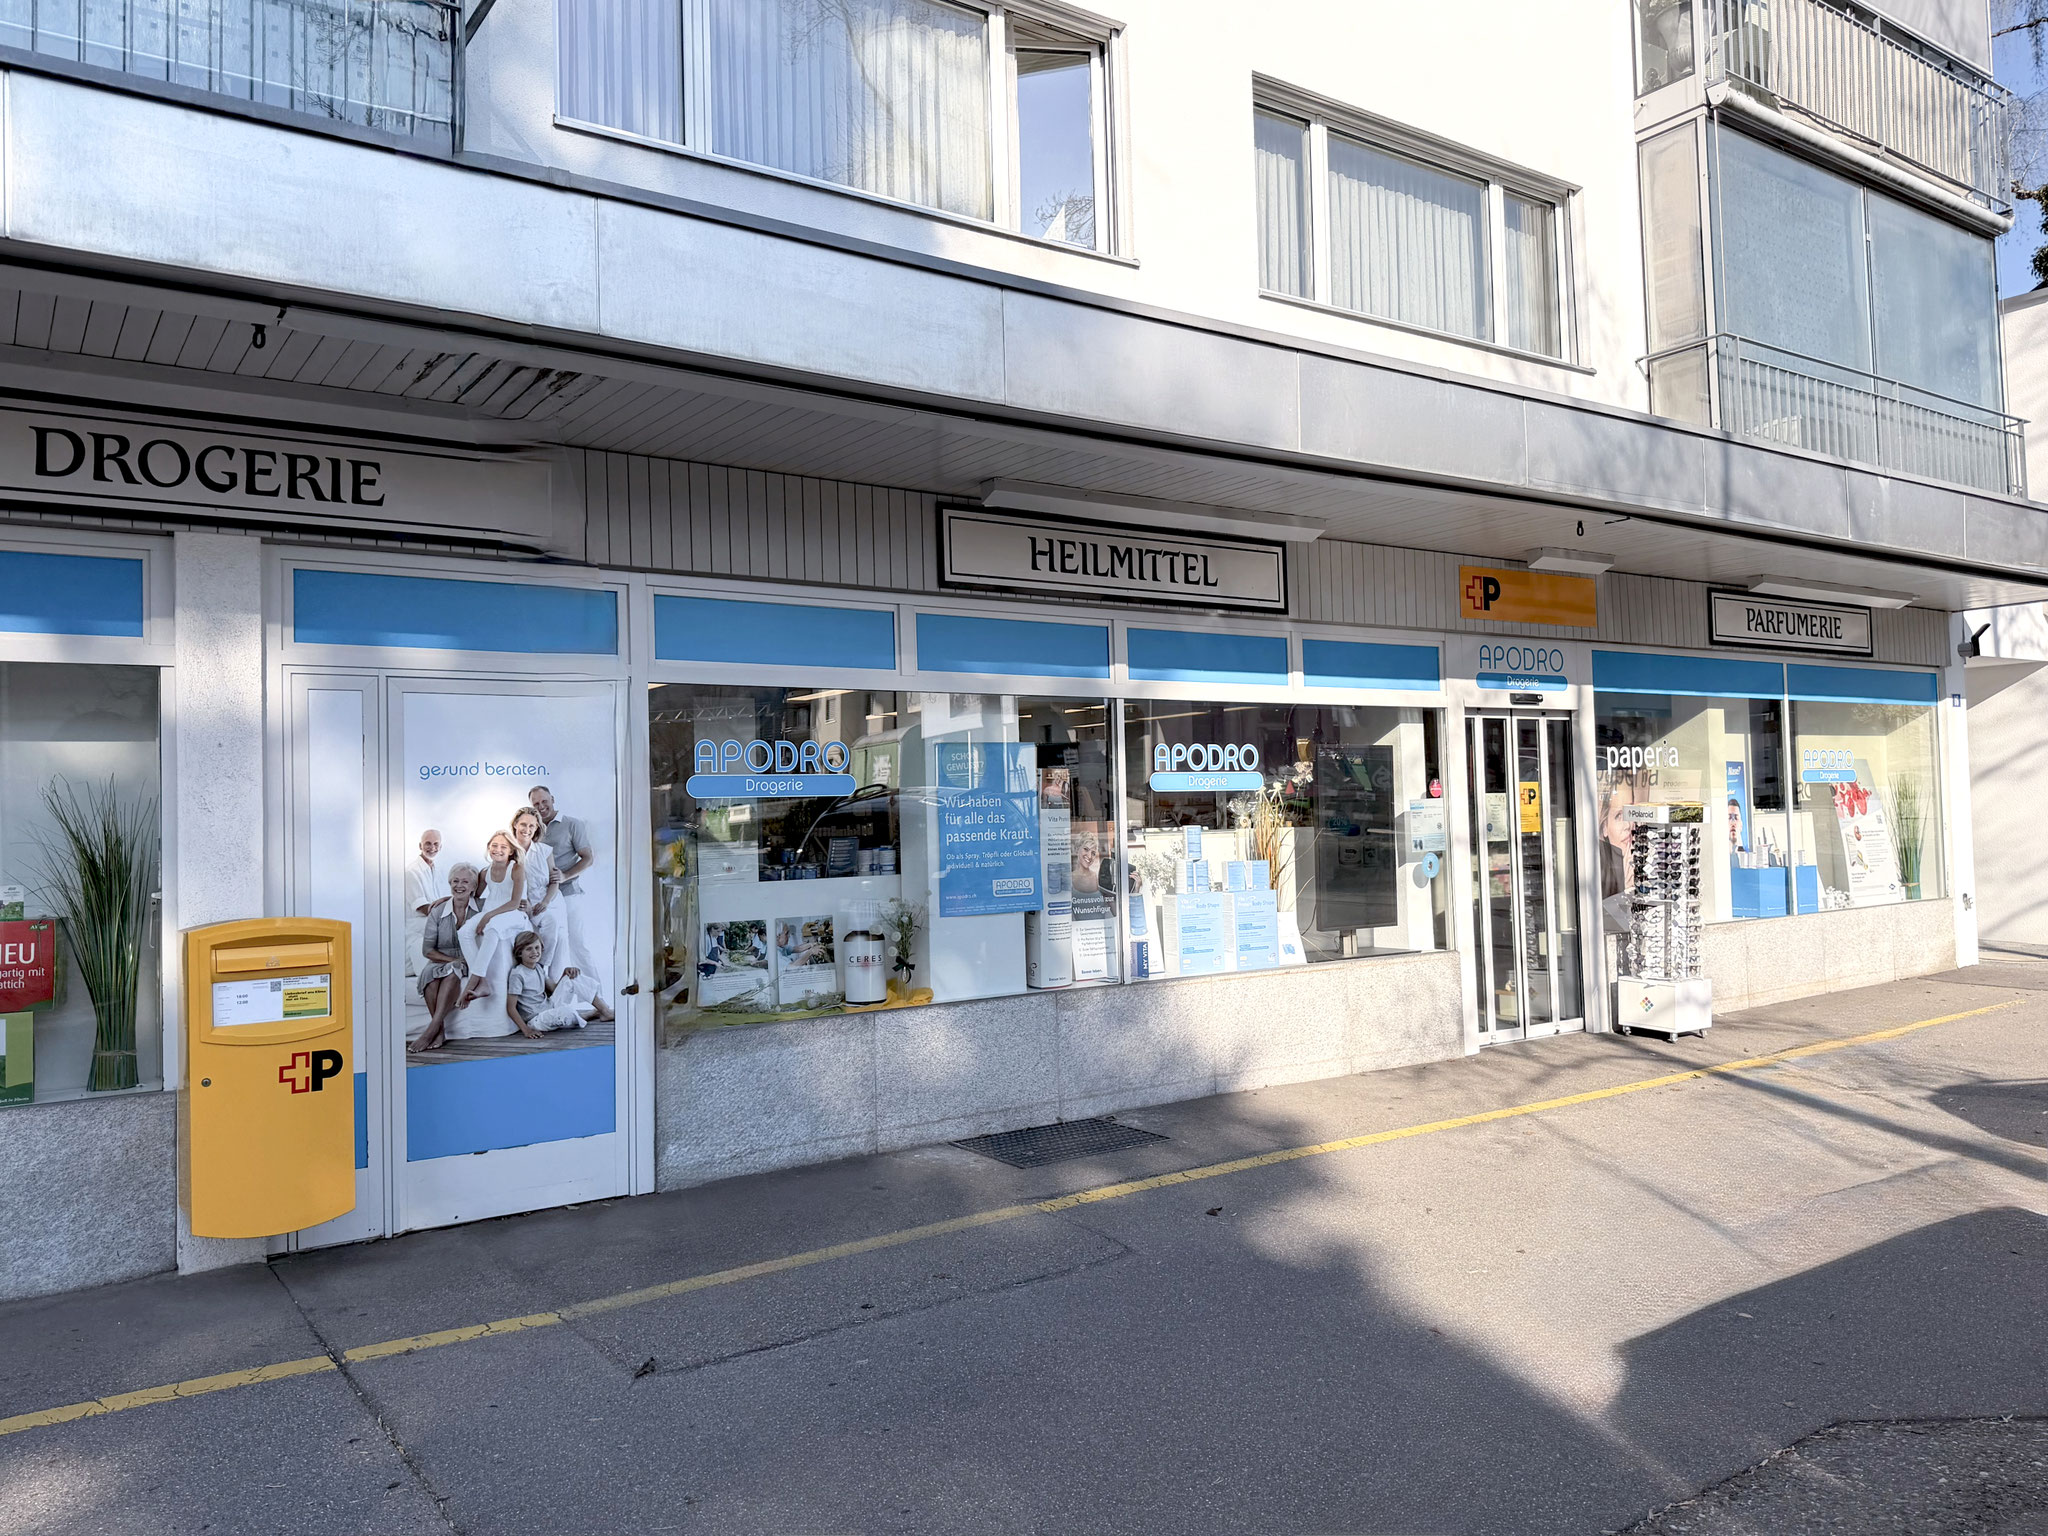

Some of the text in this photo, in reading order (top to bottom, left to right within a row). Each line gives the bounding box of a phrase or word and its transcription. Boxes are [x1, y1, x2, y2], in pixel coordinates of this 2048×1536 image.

[28, 425, 385, 507] DROGERIE
[1027, 536, 1218, 587] HEILMITTEL
[1745, 608, 1843, 639] PARFUMERIE
[1479, 644, 1564, 672] APODRO
[1506, 675, 1540, 689] Drogerie
[694, 739, 850, 773] APODRO
[951, 752, 978, 761] SCHO
[1154, 743, 1260, 771] APODRO
[1606, 740, 1680, 775] paperia
[1803, 749, 1855, 768] APODRO
[420, 762, 550, 780] gesund beraten.
[745, 778, 804, 794] Drogerie
[1188, 775, 1228, 789] Drogerie
[944, 795, 1002, 808] Wir haben
[945, 811, 1006, 825] für alle das
[1632, 810, 1654, 818] Polaroid
[946, 827, 1033, 846] passende Kraut.
[996, 879, 1031, 889] APODRO
[1072, 896, 1104, 904] Genussvoll
[1072, 905, 1112, 914] Wunschfigur
[0, 942, 36, 965] EU
[849, 955, 883, 964] CERES
[28, 966, 45, 977] mit
